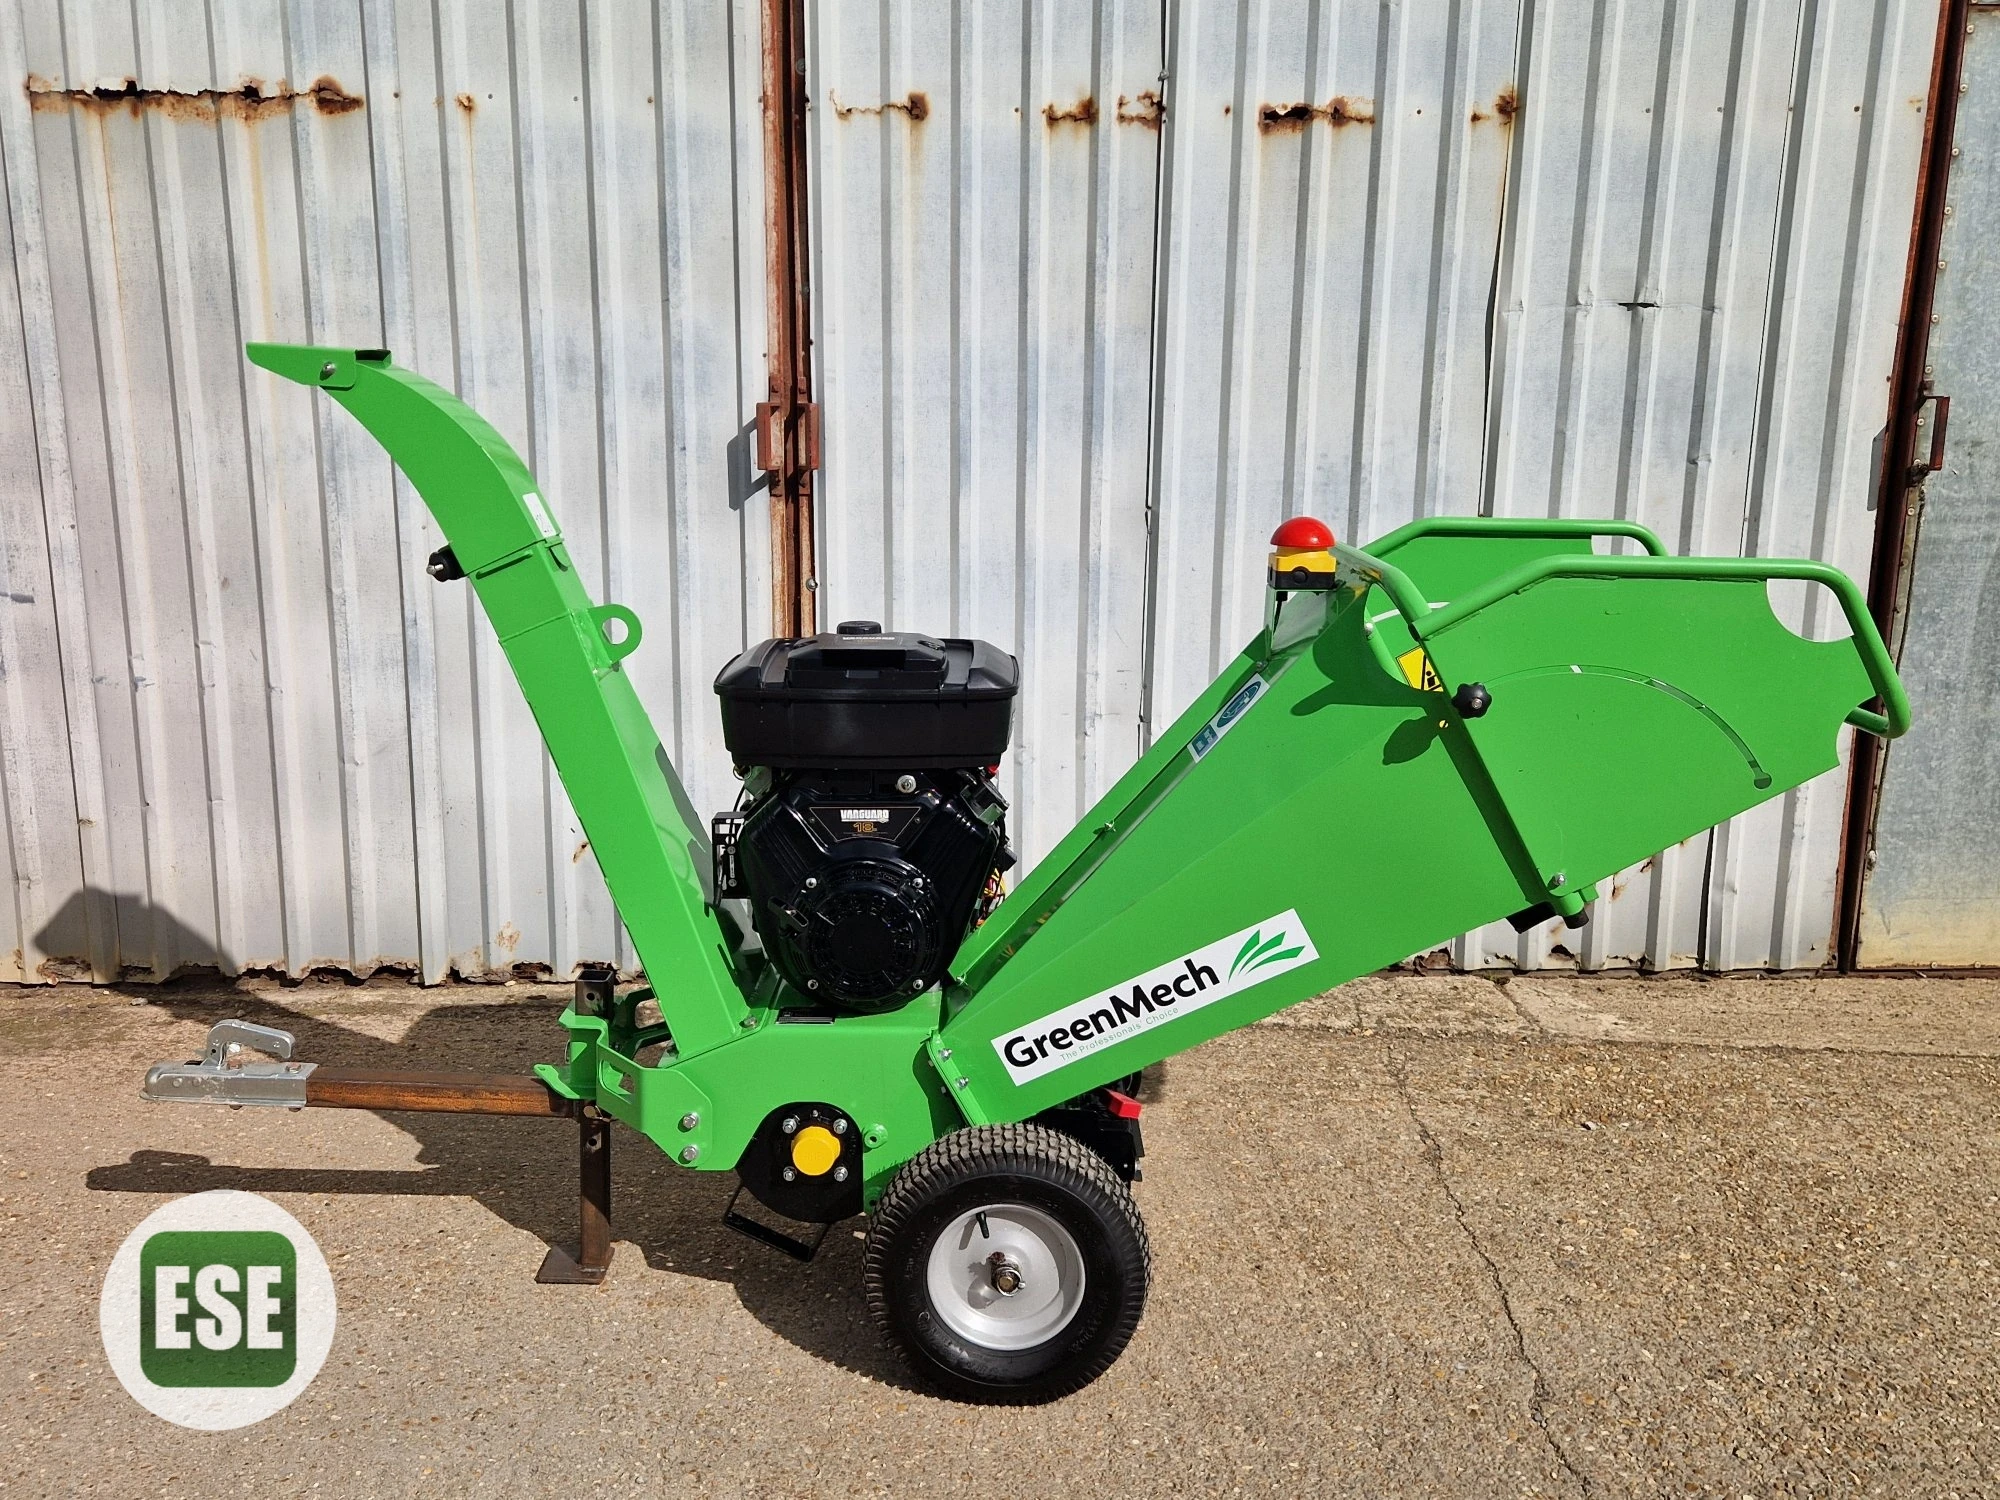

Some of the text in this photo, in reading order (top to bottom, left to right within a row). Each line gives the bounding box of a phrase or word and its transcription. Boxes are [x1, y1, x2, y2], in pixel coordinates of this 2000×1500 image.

[840, 809, 889, 819] VANGUARD
[853, 822, 873, 832] 18
[1004, 958, 1220, 1067] GreenMech
[1059, 1049, 1079, 1063] The
[1145, 1006, 1179, 1025] Choice
